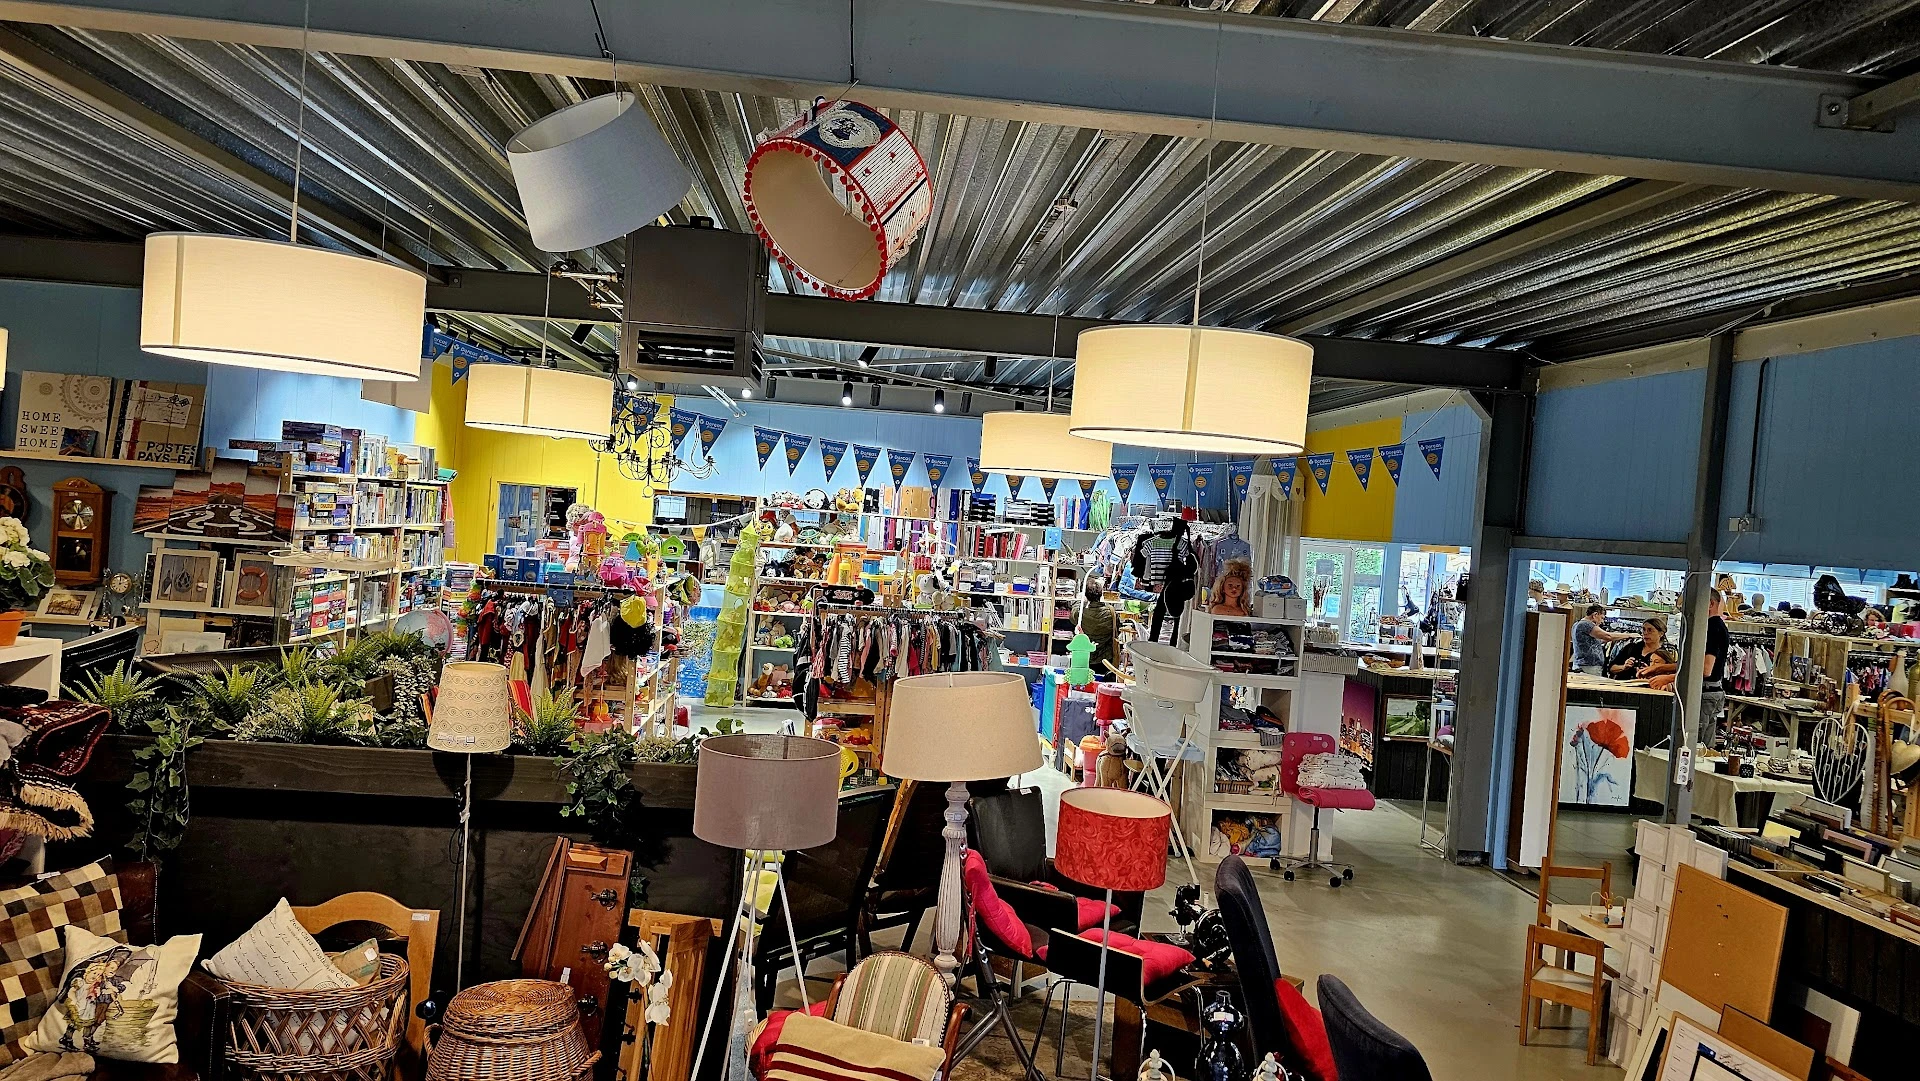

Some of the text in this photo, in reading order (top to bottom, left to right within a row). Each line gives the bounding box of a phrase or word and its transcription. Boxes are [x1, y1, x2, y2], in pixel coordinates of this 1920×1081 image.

[460, 346, 479, 357] Dorcas
[21, 410, 61, 423] HOME
[676, 413, 695, 422] Dorcas
[705, 420, 723, 429] Dorcas
[18, 437, 59, 449] HOME
[146, 441, 198, 456] POSTES
[290, 918, 302, 932] Post
[300, 931, 314, 946] Card
[335, 972, 351, 988] Carte
